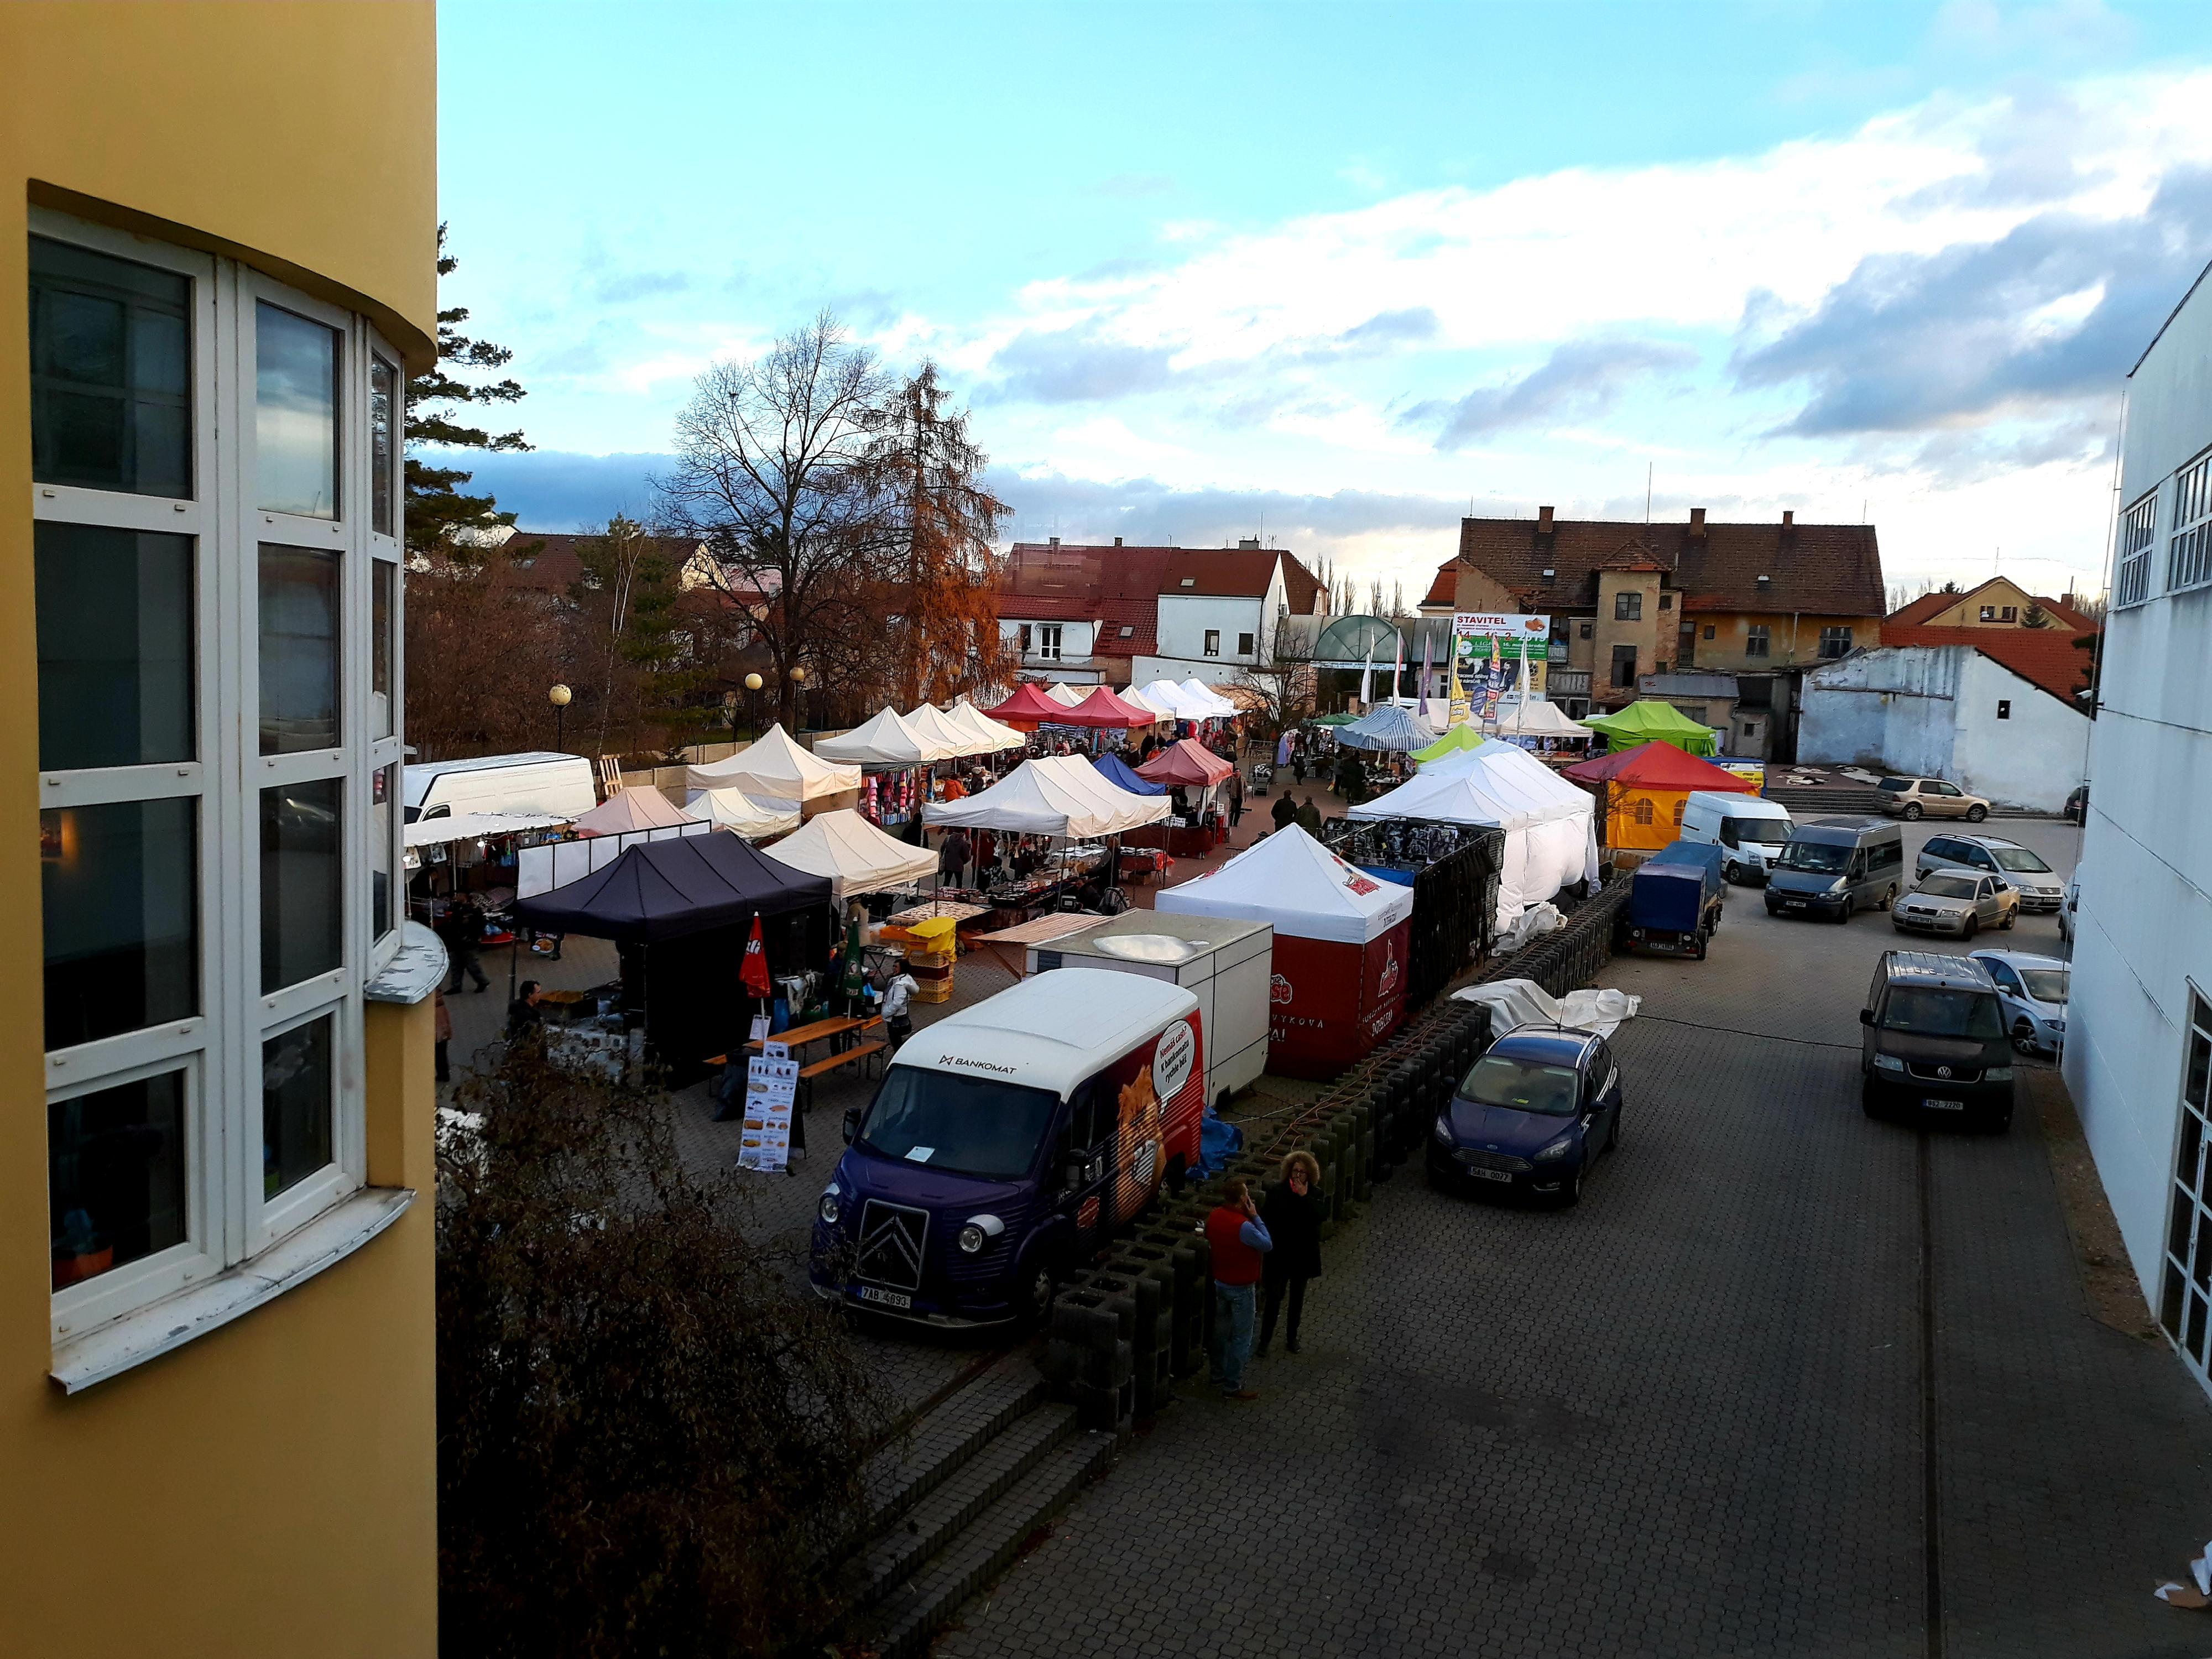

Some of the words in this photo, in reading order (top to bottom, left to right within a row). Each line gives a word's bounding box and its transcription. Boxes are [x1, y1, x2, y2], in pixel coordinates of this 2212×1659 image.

[1457, 616, 1506, 624] STAVITEL
[1175, 1025, 1187, 1044] cash?
[1161, 1062, 1165, 1073] K
[1165, 1039, 1190, 1068] bankomatu
[955, 1058, 1017, 1074] BANKOMAT
[1166, 1064, 1179, 1083] rychle
